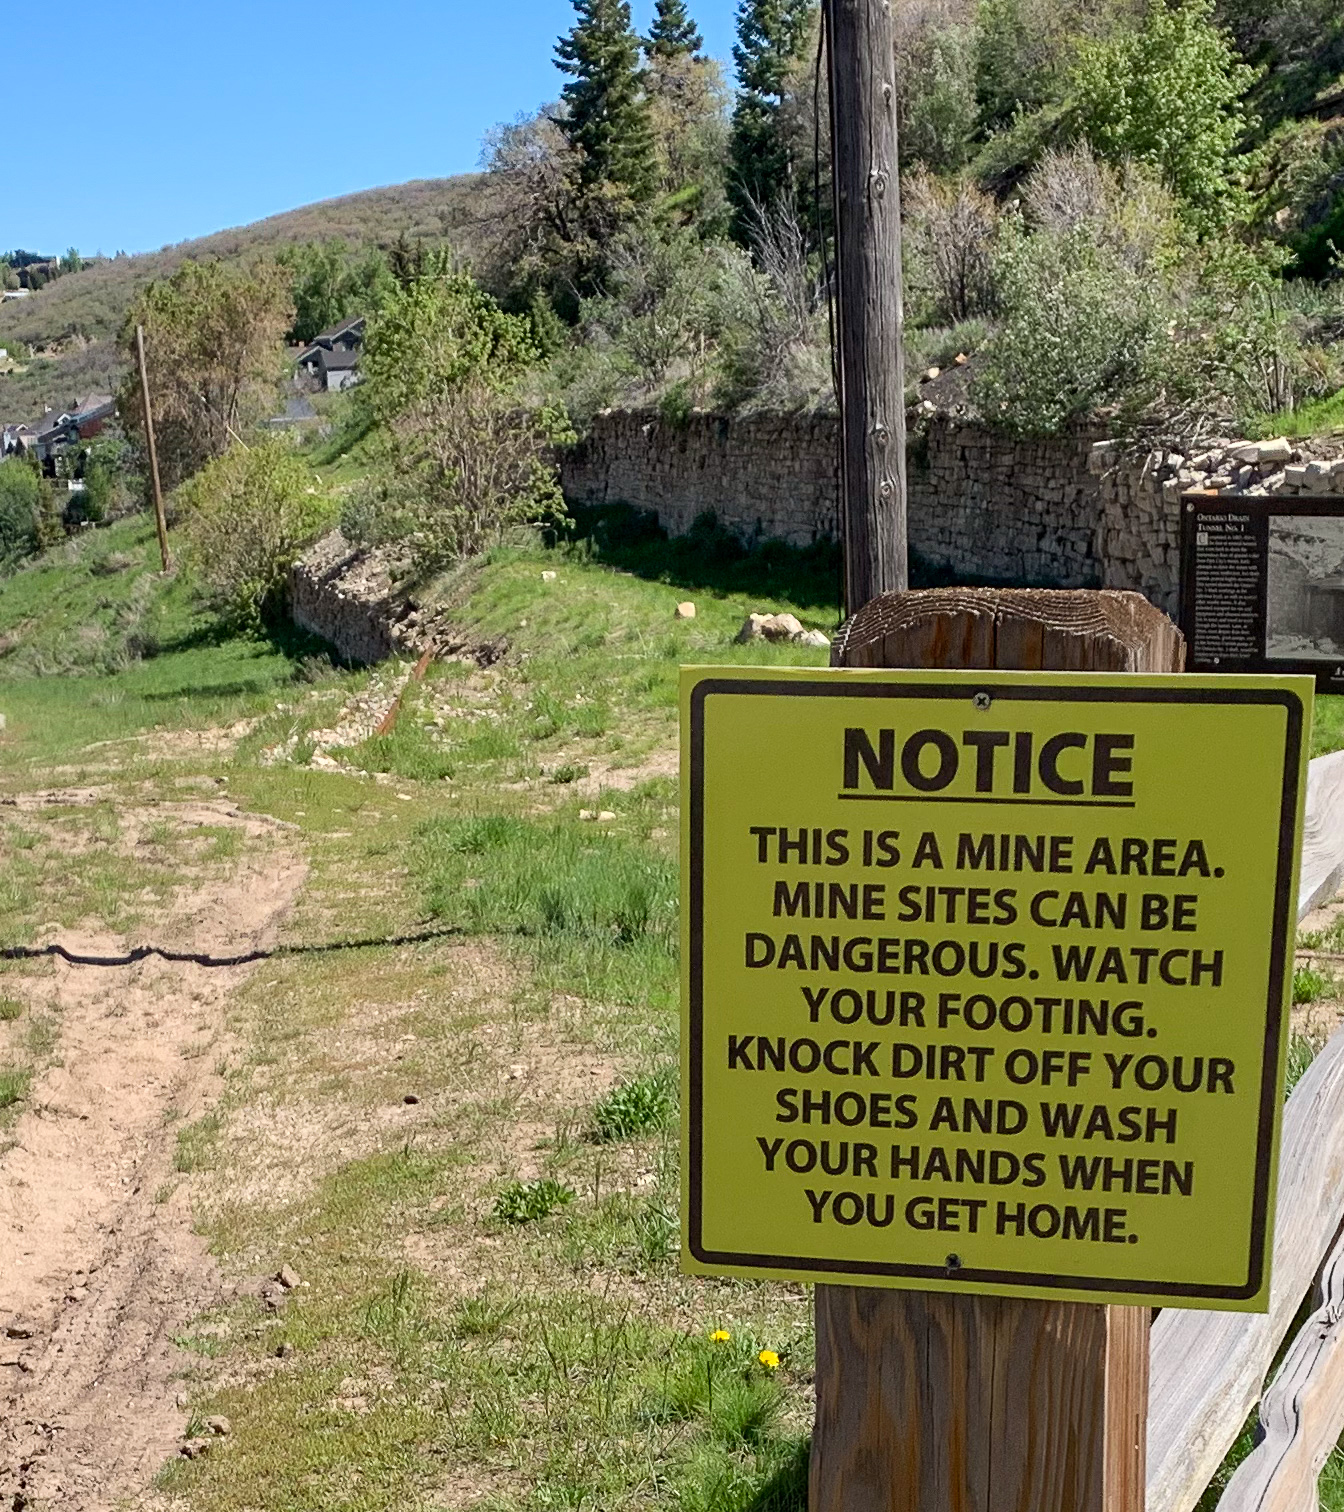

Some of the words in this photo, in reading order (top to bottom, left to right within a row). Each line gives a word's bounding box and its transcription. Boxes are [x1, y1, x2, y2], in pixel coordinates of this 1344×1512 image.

[843, 727, 1136, 797] NOTICE
[750, 825, 850, 867] THIS
[862, 829, 901, 868] IS
[911, 831, 944, 870] A
[955, 833, 1074, 875] MINE
[1083, 836, 1226, 879] AREA.
[771, 880, 886, 921] MINE
[897, 884, 1018, 926] SITES
[1029, 889, 1128, 931] CAN
[1140, 893, 1198, 933] BE
[745, 932, 1040, 981] DANGEROUS.
[1051, 943, 1225, 988] WATCH
[800, 985, 926, 1028] YOUR
[937, 992, 1158, 1039] FOOTING.
[727, 1034, 882, 1077] KNOCK
[891, 1042, 995, 1083] DIRT
[1004, 1048, 1093, 1088] OFF
[1102, 1052, 1236, 1095] YOUR
[775, 1087, 919, 1130] SHOES
[928, 1096, 1029, 1136] AND
[1039, 1101, 1178, 1145] WASH
[755, 1136, 879, 1178] YOUR
[890, 1144, 1047, 1188] HANDS
[1057, 1154, 1196, 1197] WHEN
[803, 1188, 895, 1228] YOU
[904, 1195, 988, 1234] GET
[995, 1200, 1139, 1245] HOME.
